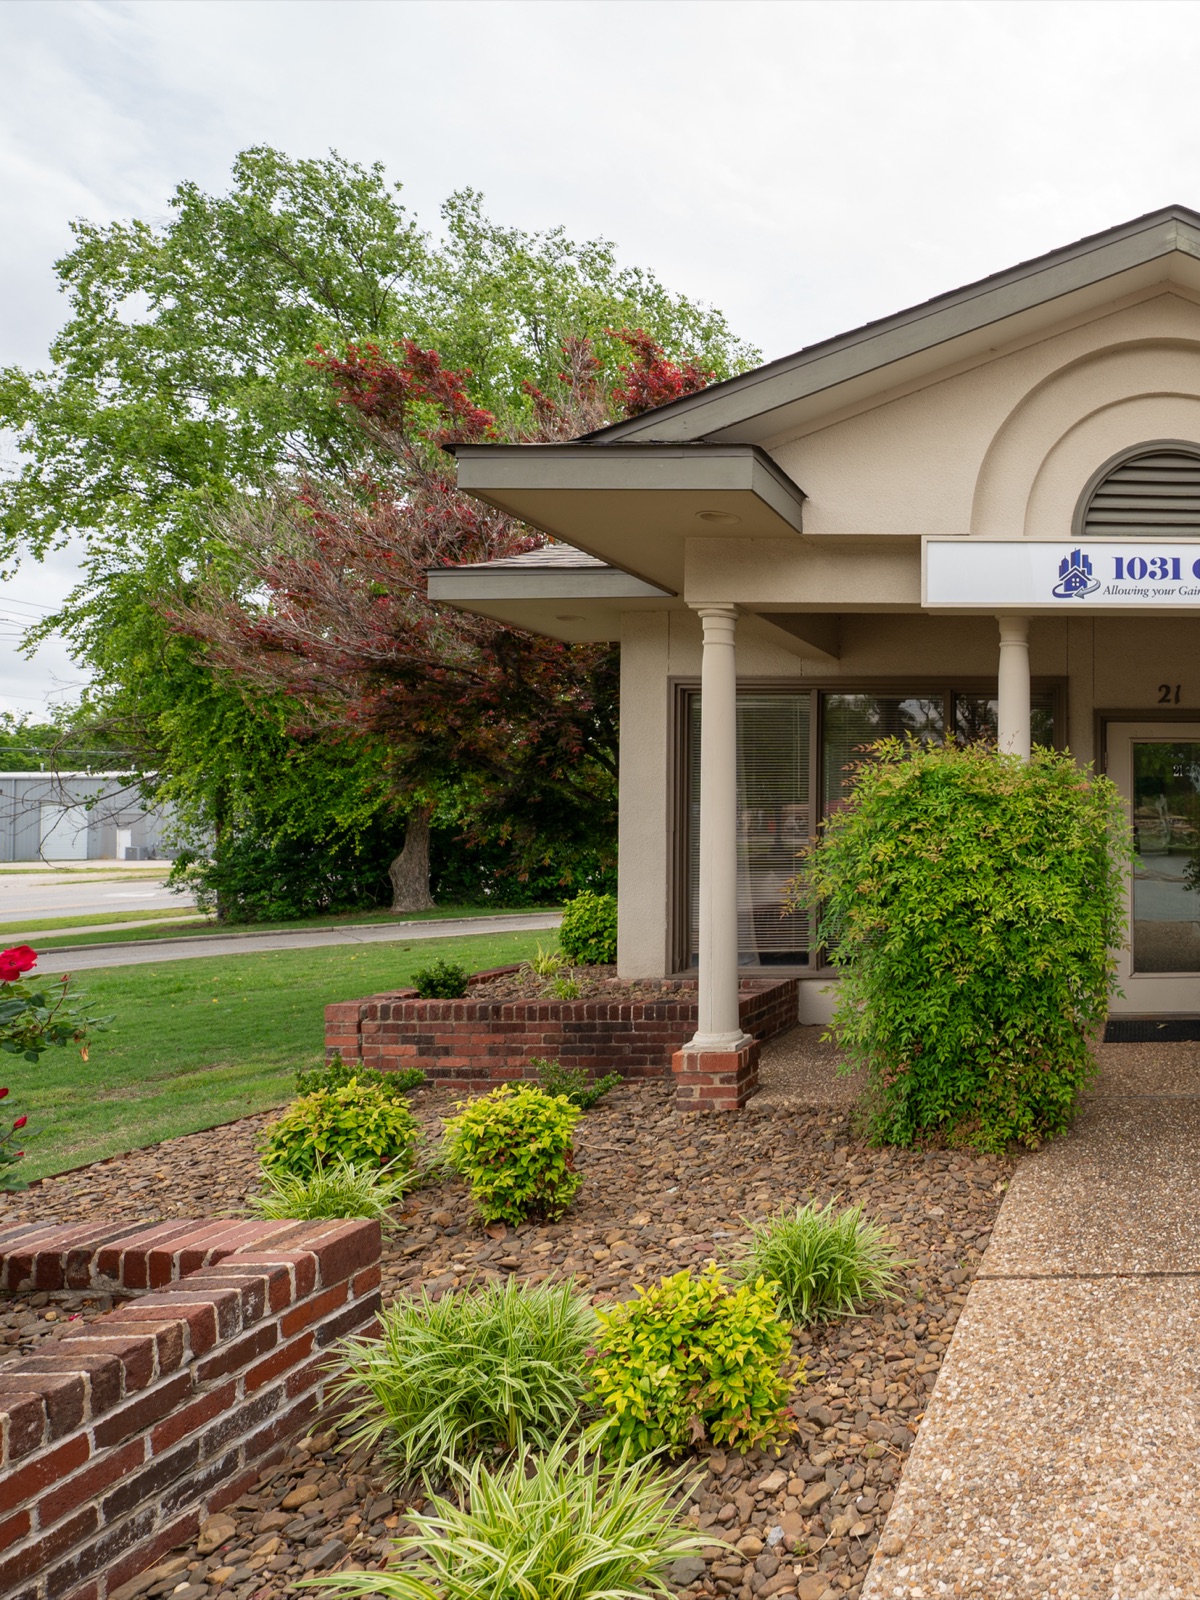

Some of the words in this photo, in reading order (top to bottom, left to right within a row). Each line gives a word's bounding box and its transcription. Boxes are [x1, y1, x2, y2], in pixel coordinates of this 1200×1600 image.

[1112, 556, 1184, 580] 1031
[1102, 585, 1149, 598] Allowing
[1151, 588, 1176, 598] your
[1157, 684, 1181, 704] 21
[1173, 764, 1183, 777] 21
